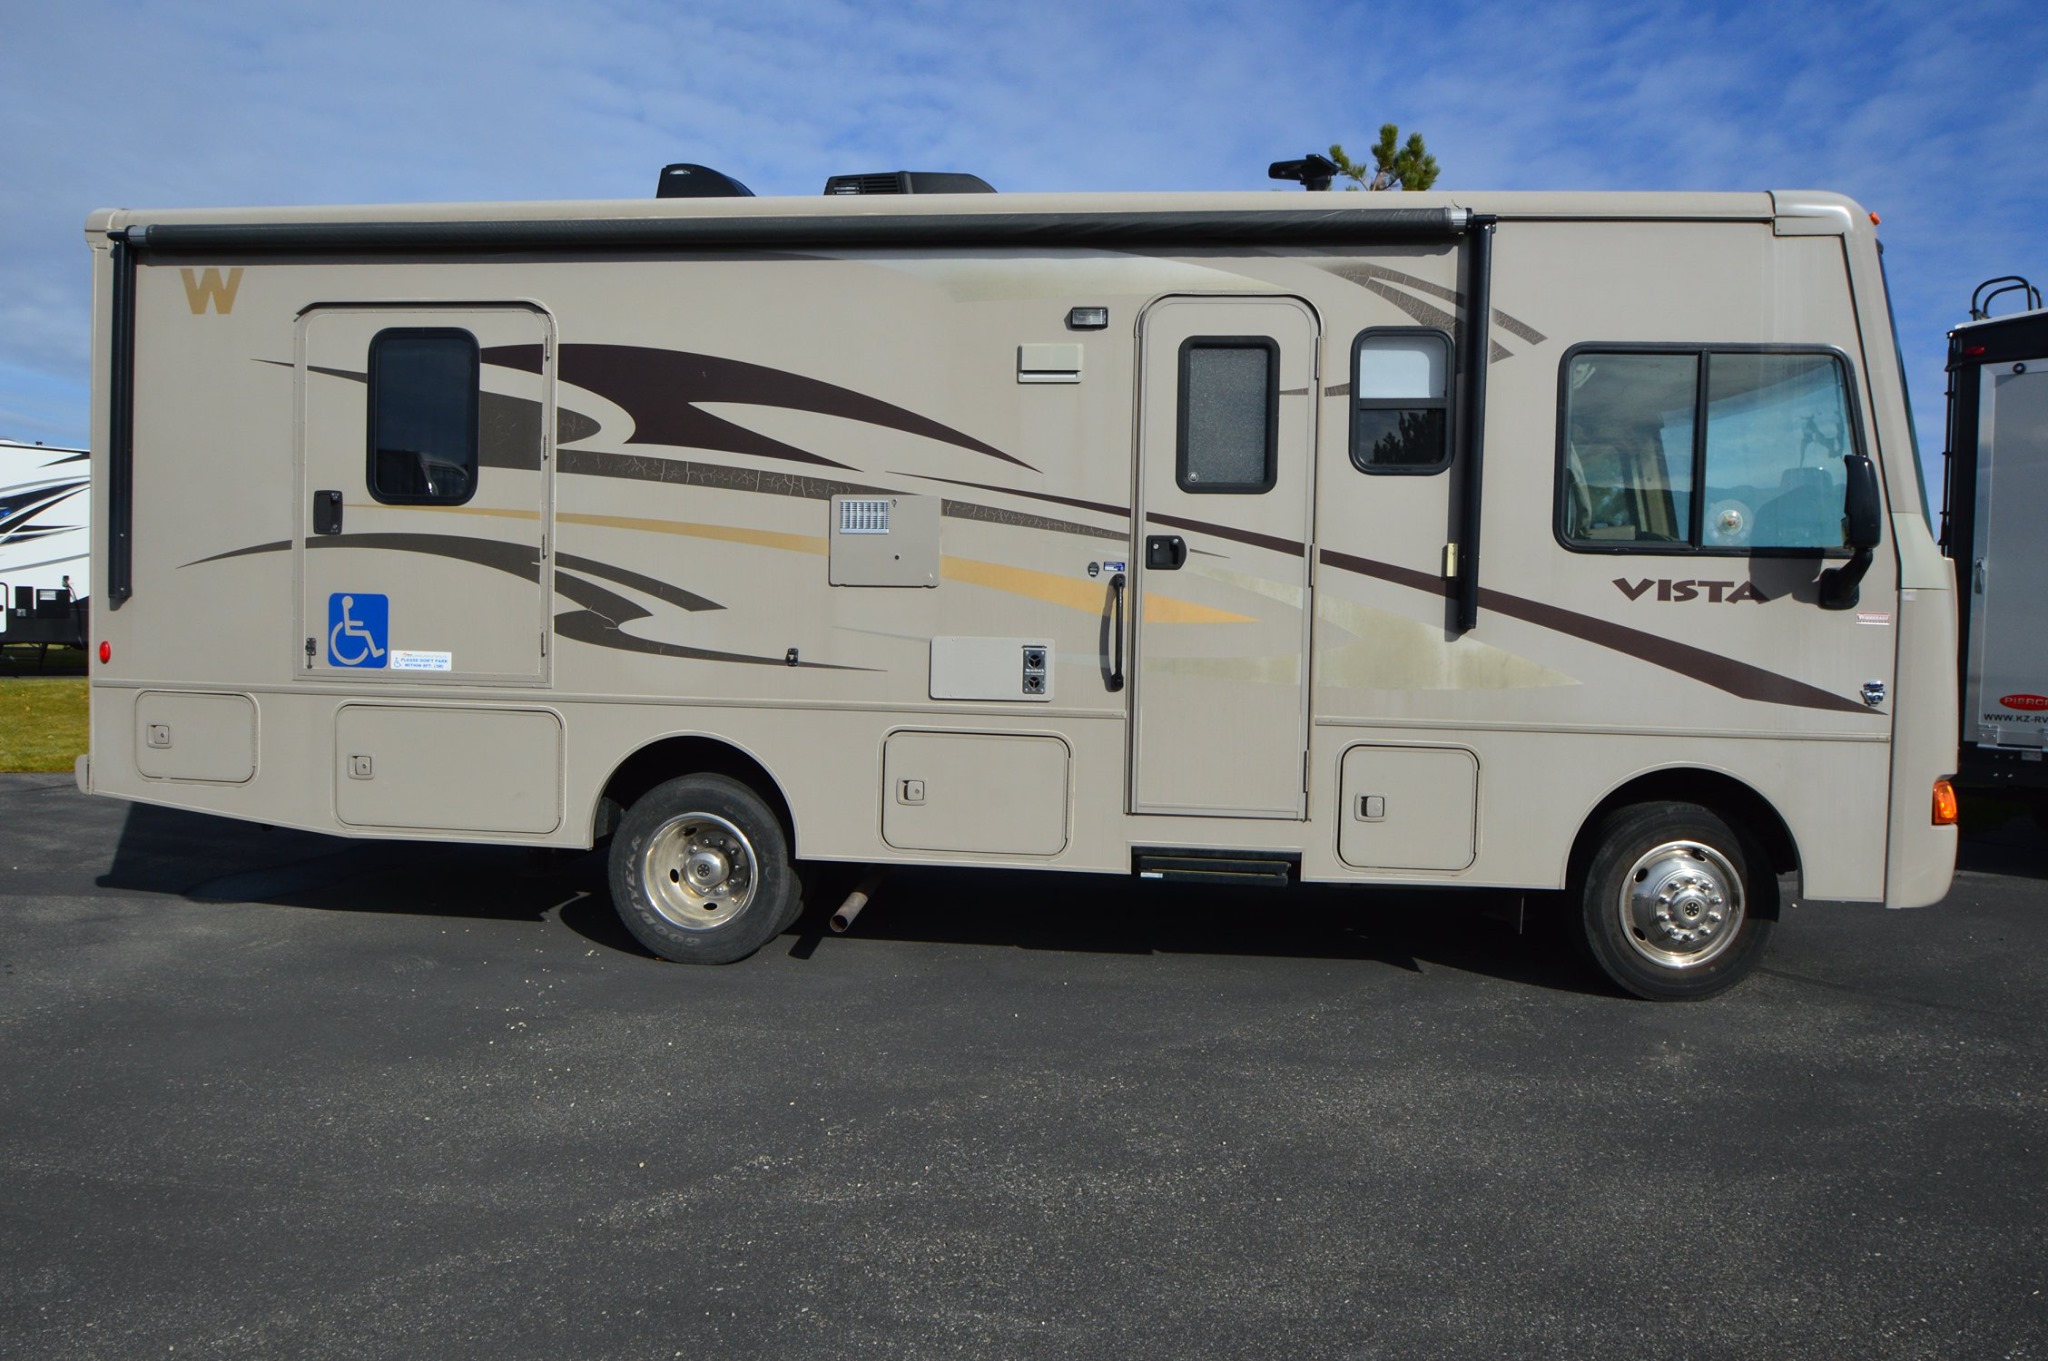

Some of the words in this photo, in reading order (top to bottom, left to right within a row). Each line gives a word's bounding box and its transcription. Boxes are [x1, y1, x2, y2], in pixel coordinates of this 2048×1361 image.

[180, 267, 245, 315] W
[1612, 577, 1772, 605] VISTA
[626, 835, 700, 946] GOODYEAR
